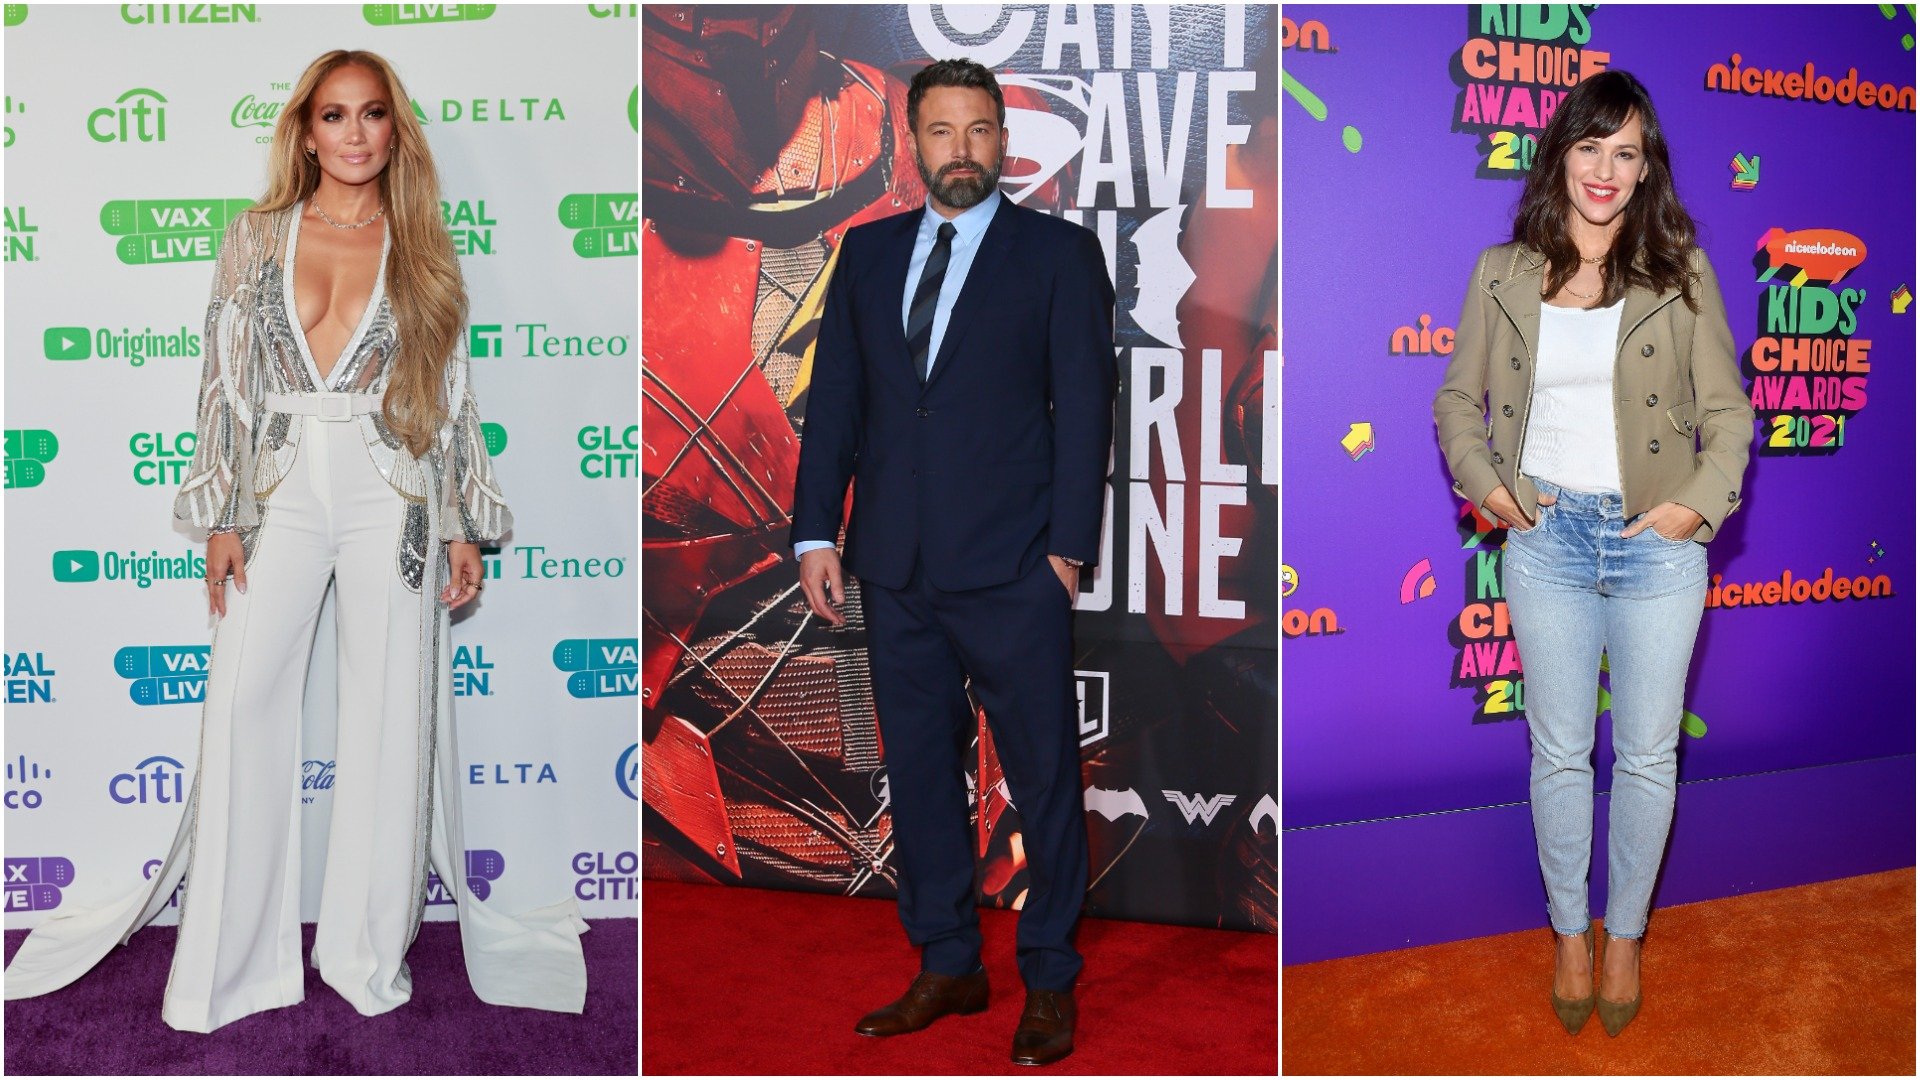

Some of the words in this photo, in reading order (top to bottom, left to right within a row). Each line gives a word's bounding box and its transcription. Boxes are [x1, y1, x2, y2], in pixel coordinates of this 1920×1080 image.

[270, 82, 291, 91] THE
[1707, 53, 1916, 111] nickelodeon
[87, 97, 167, 143] citi
[442, 98, 566, 122] DELTA
[151, 207, 211, 228] VAX
[151, 236, 211, 259] LIVE
[1785, 240, 1857, 257] nickelodeon
[96, 326, 200, 367] Originals
[516, 324, 628, 357] Teneo
[1752, 337, 1872, 373] CHOICE
[1751, 376, 1868, 411] AWARDS
[1769, 414, 1846, 448] 2021
[104, 550, 206, 588] Originals
[515, 546, 624, 579] Teneo
[163, 680, 207, 700] LIV
[109, 764, 183, 804] citi
[469, 763, 557, 785] ELTA
[572, 851, 638, 875] GLO
